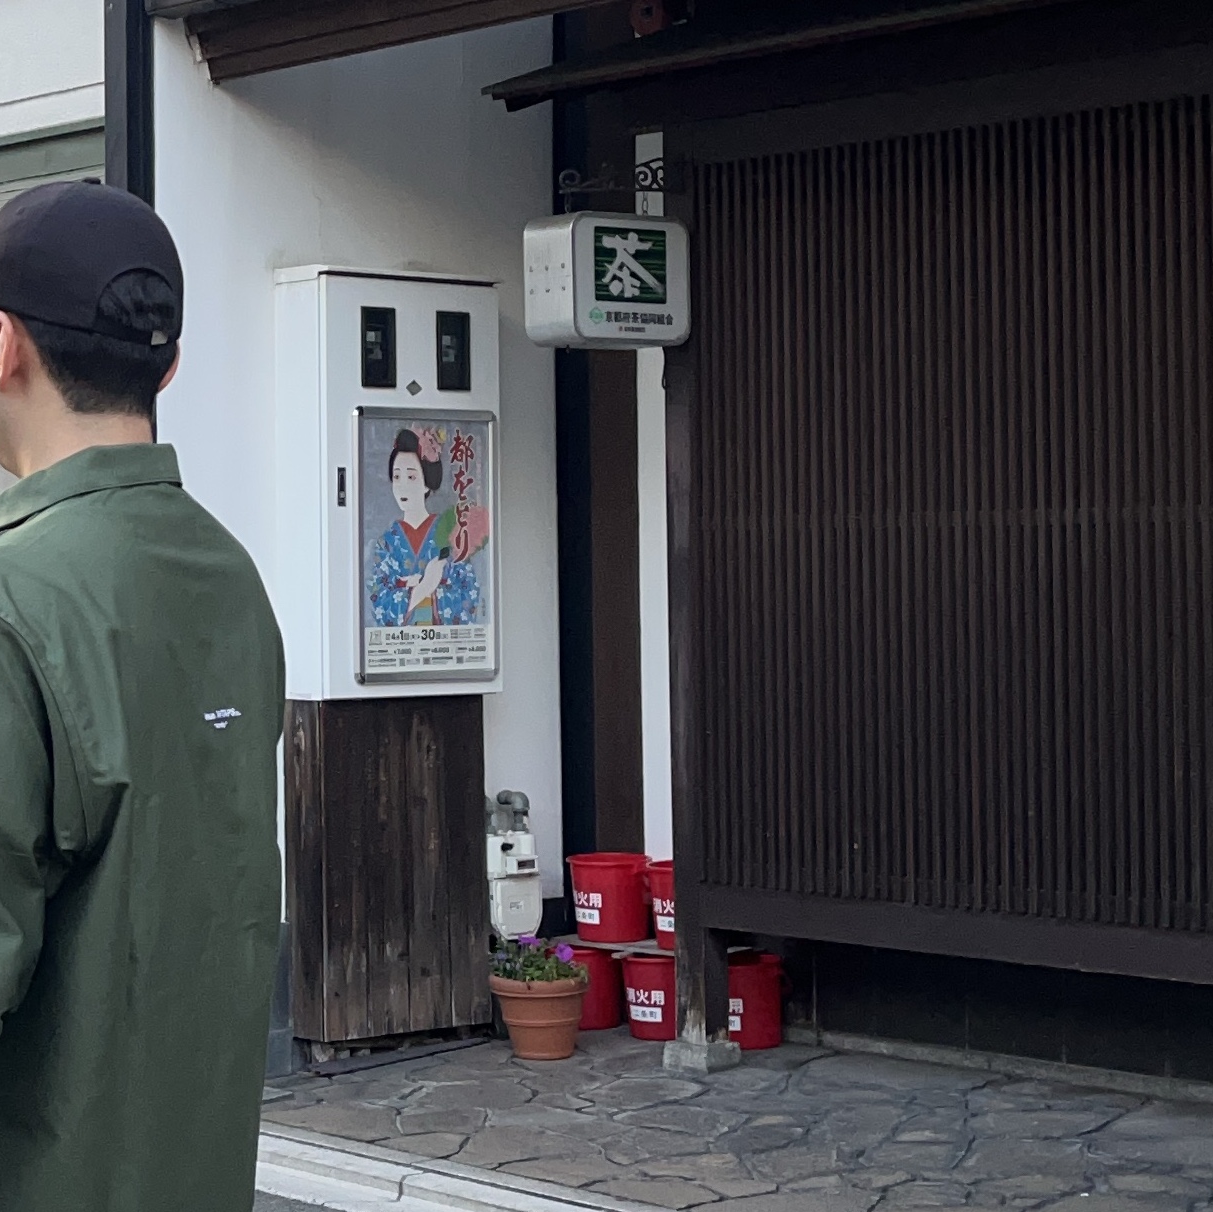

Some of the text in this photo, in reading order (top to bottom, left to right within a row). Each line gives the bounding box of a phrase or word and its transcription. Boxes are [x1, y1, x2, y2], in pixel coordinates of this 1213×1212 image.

[602, 232, 664, 298] 茶
[450, 429, 475, 563] 都をどり
